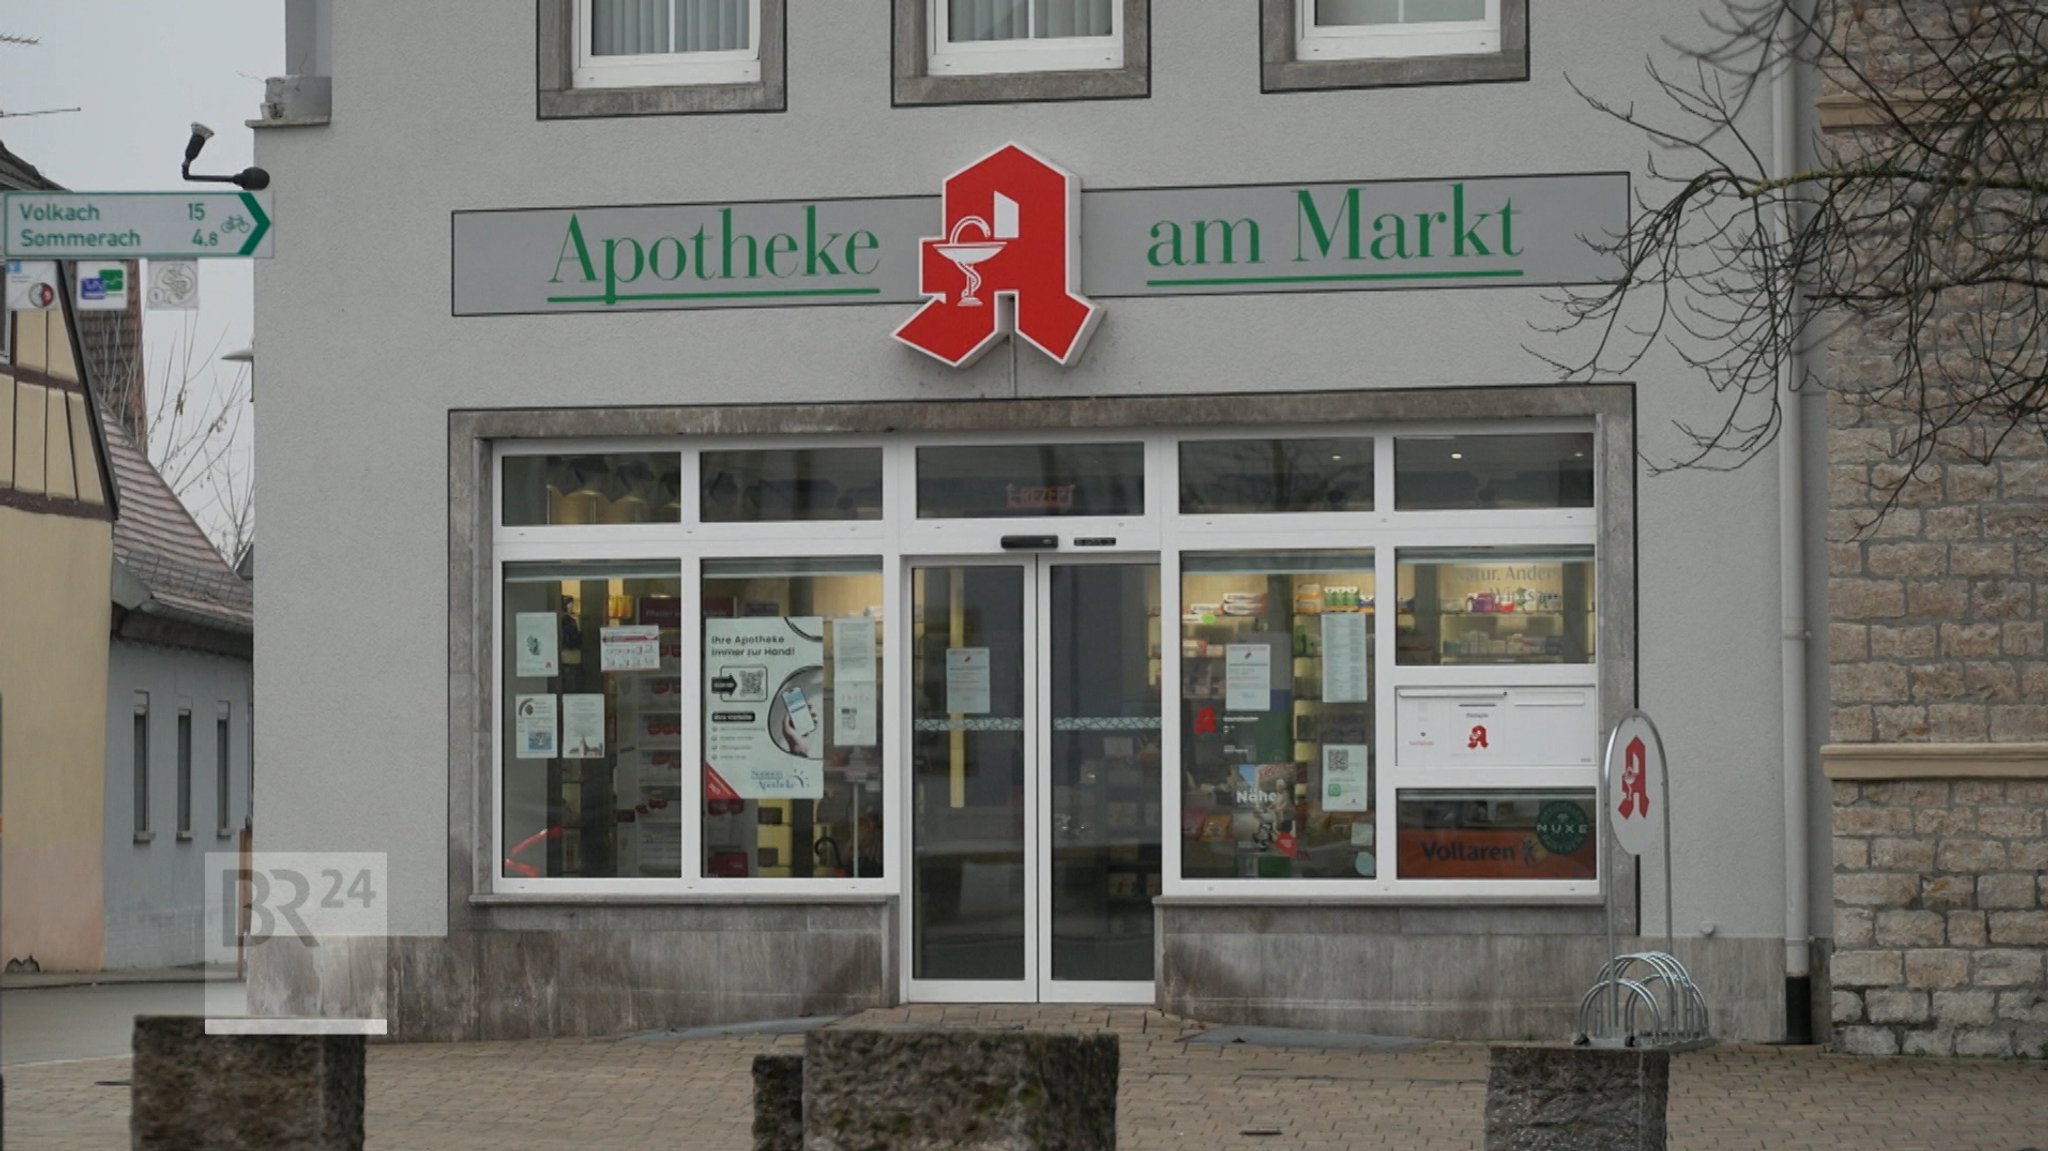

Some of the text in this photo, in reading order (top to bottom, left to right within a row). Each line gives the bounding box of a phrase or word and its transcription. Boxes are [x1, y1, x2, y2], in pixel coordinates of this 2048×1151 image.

[20, 202, 206, 221] Volkach 15
[1146, 182, 1526, 267] am Markt
[21, 228, 141, 247] Sommerach
[547, 205, 881, 305] Apotheke
[711, 635, 785, 647] Ihre Apotheke
[764, 648, 795, 656] Hand!
[1536, 823, 1588, 834] NUXE
[1421, 840, 1515, 861] Voltaren
